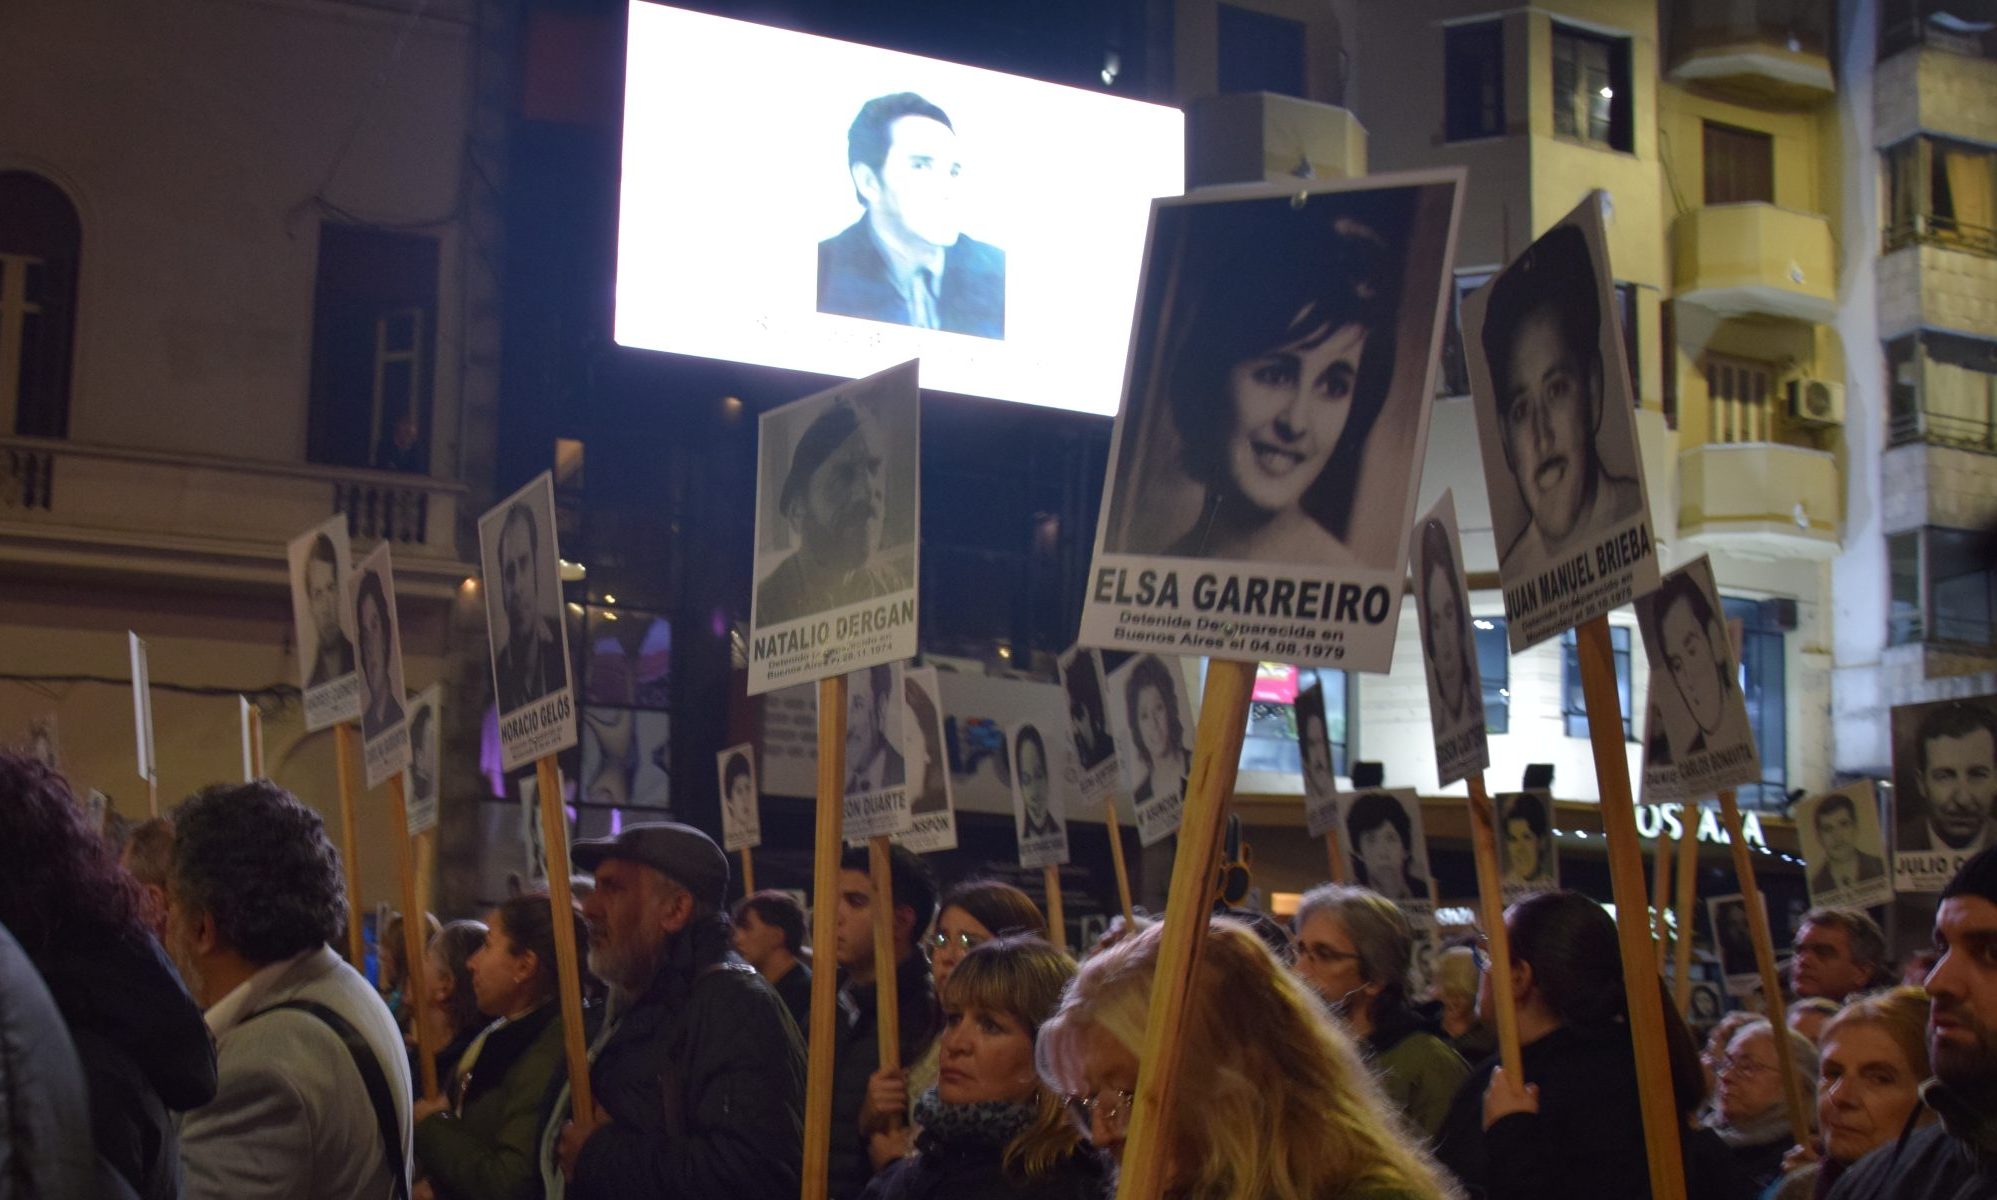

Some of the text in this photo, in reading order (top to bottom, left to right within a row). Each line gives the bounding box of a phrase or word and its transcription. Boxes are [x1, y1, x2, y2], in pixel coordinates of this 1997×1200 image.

[1506, 522, 1652, 622] JUAN MANUEL BRIEBA
[1093, 568, 1391, 625] ELSA GARREIRO
[754, 598, 915, 662] NATALIO DERGAN
[1114, 627, 1346, 660] Buenos Aires el 04.08.1979
[1119, 609, 1191, 629] Detenida
[1320, 629, 1345, 643] en
[501, 708, 539, 745] HORACIO
[1896, 855, 1947, 875] JULIO
